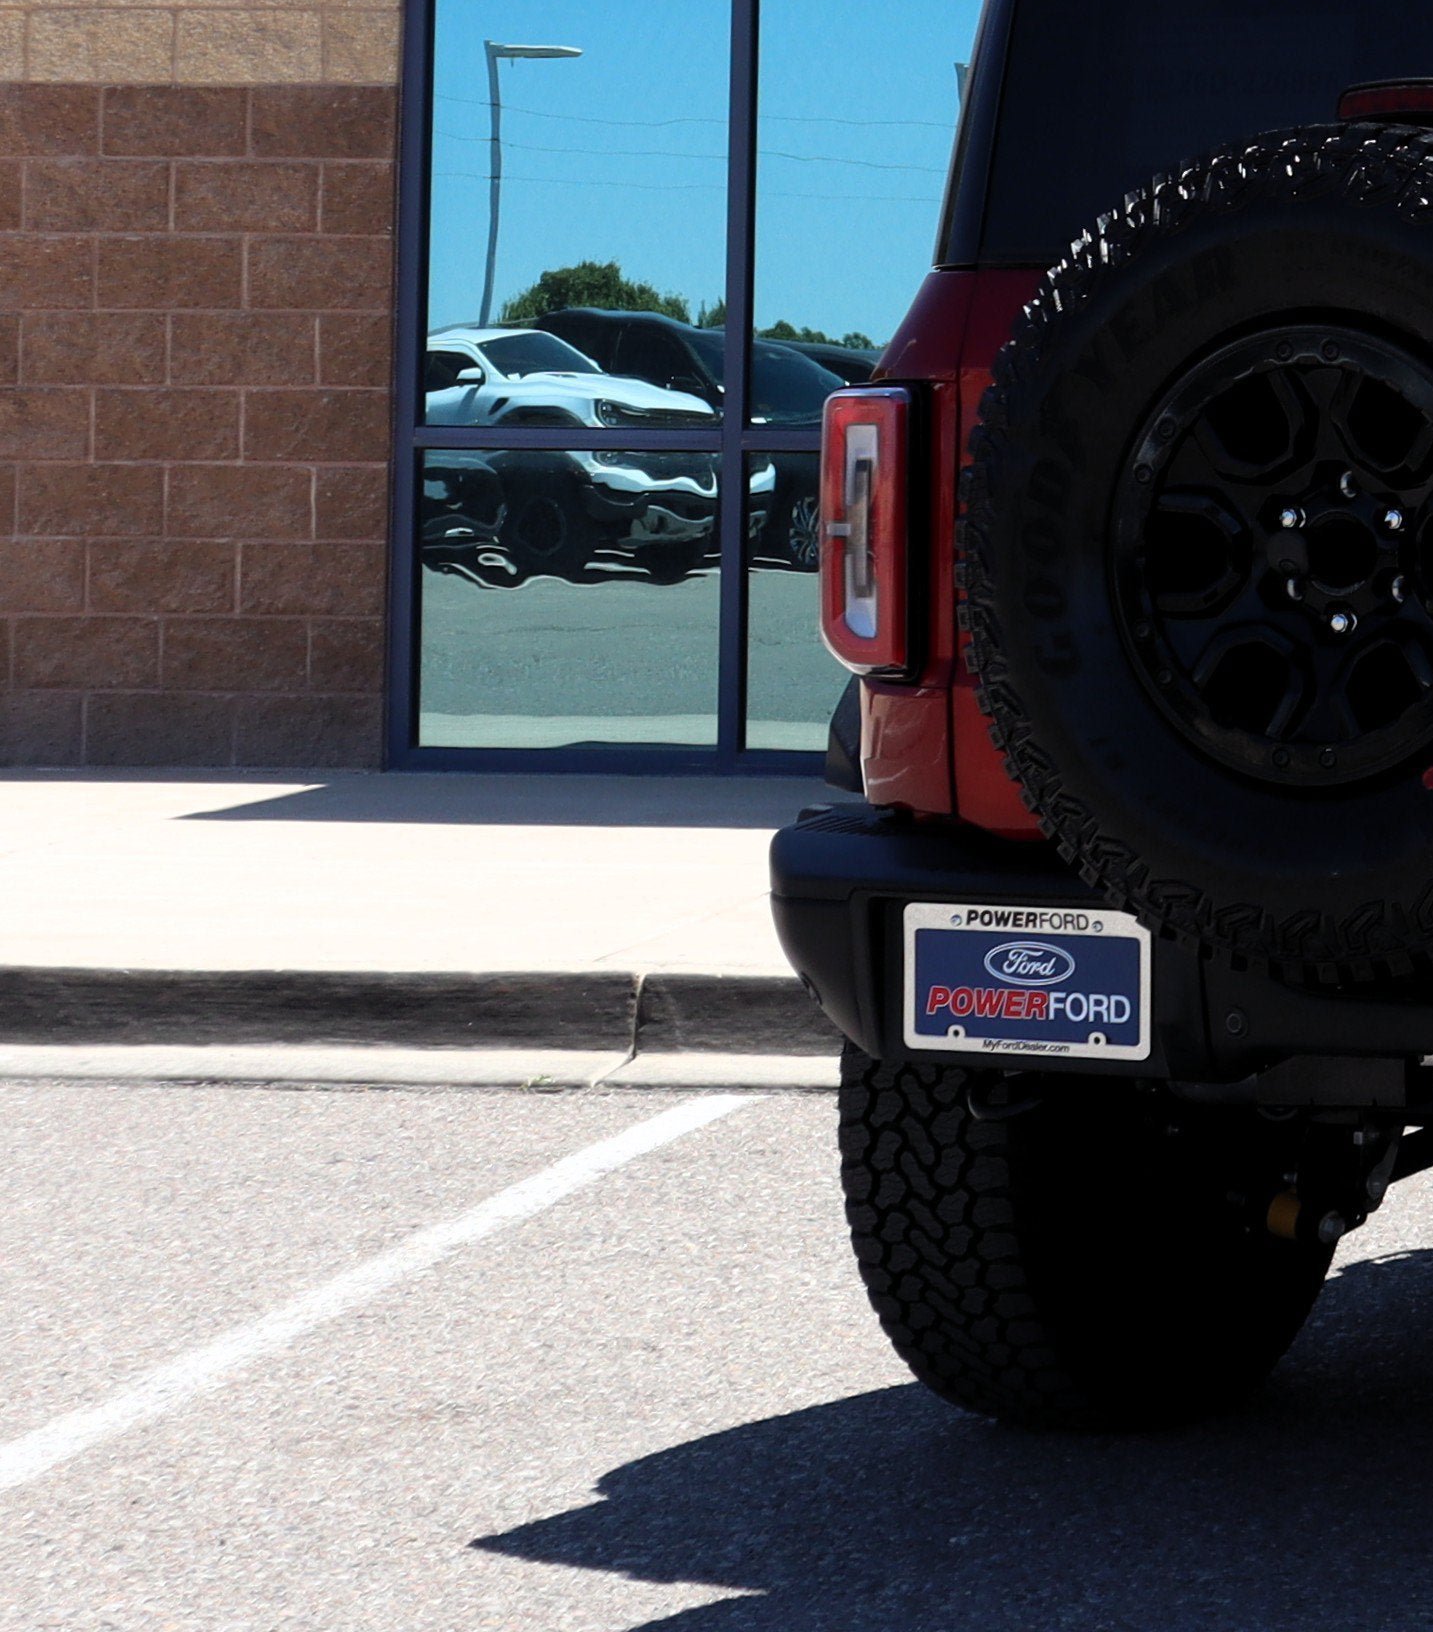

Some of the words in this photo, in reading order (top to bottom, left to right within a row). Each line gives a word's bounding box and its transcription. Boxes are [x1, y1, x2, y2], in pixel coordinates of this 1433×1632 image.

[965, 909, 1090, 931] POWERFORD
[1002, 948, 1056, 976] Ford
[926, 985, 1132, 1024] POWERFORD
